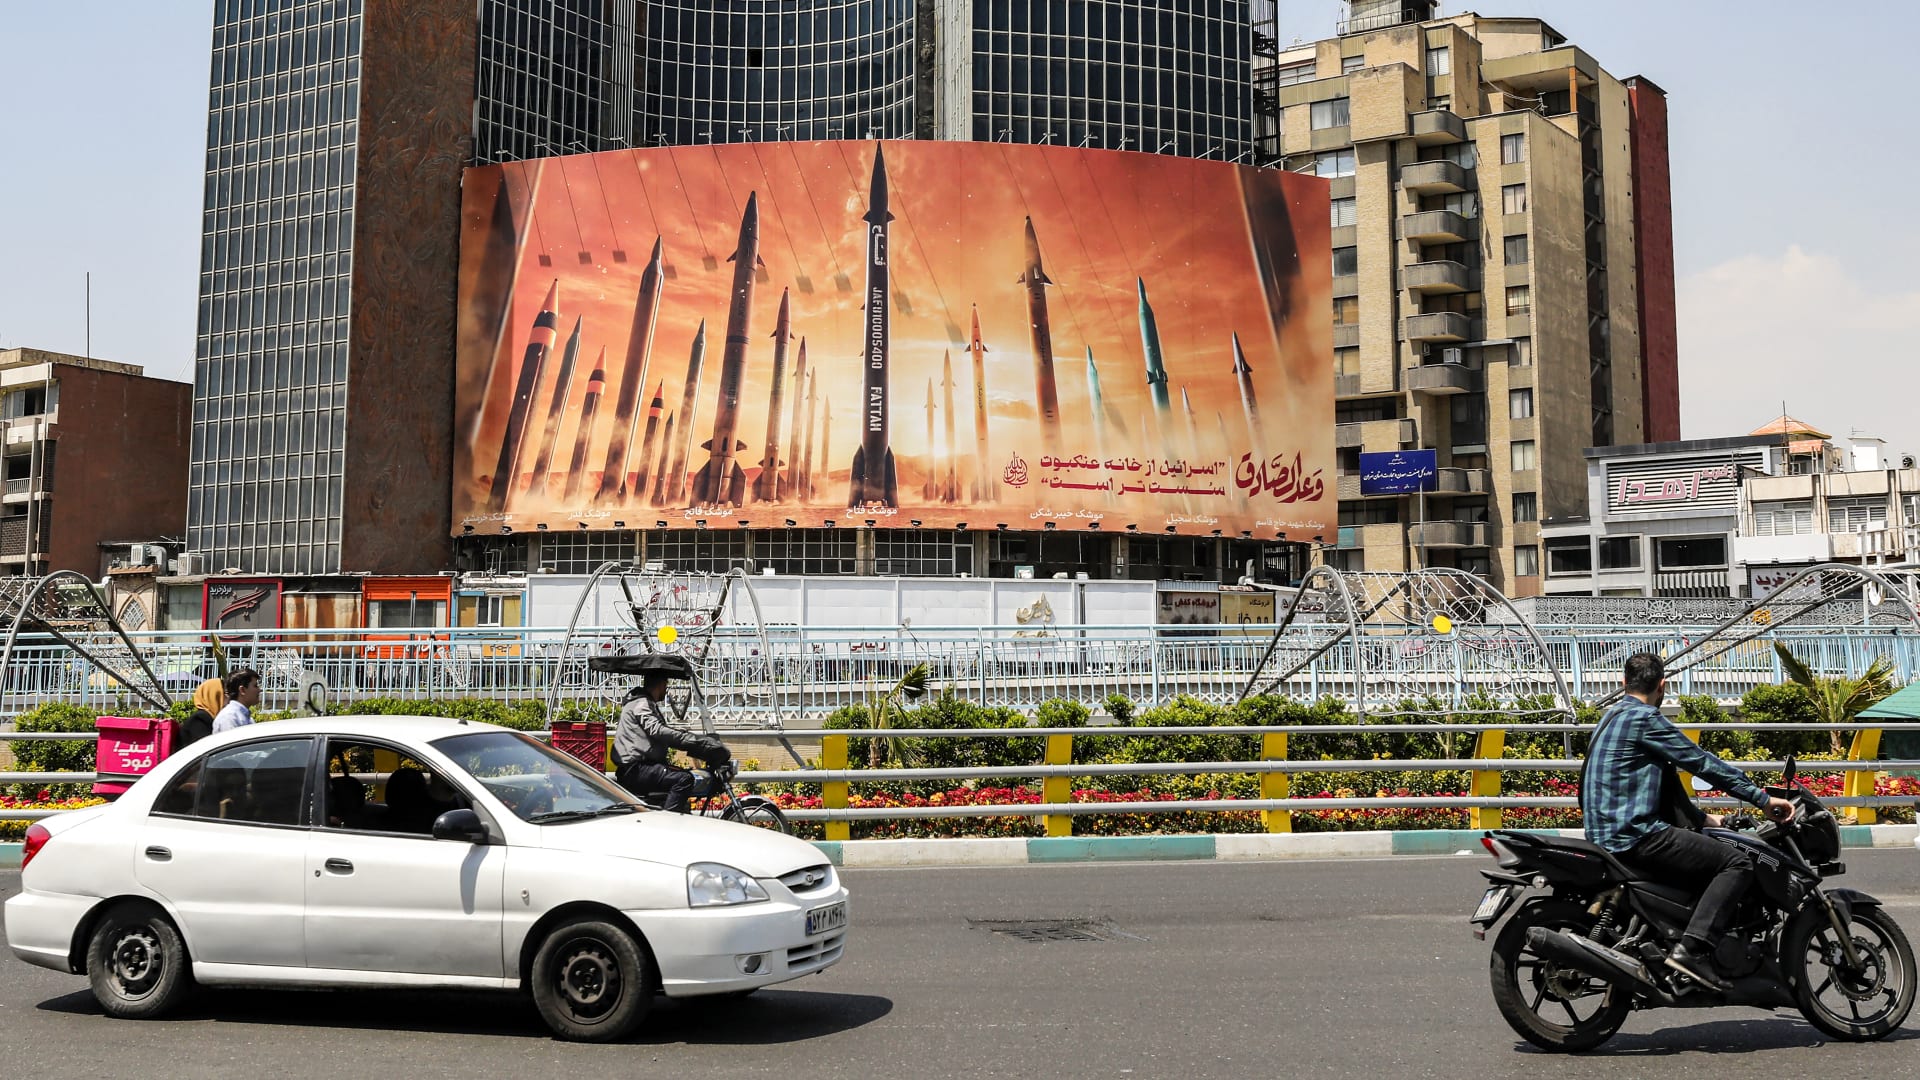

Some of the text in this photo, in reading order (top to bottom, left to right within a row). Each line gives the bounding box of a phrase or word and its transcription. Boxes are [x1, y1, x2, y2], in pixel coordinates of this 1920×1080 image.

[870, 386, 883, 431] FATTAH
[1040, 454, 1100, 472] عنکبوت
[1104, 457, 1142, 472] خانه
[1145, 459, 1156, 476] از
[1118, 480, 1146, 496] تر
[489, 513, 513, 522] موشک
[585, 510, 611, 519] موشک
[684, 506, 733, 519] موشک فاتح
[845, 506, 898, 518] موشک فتاح
[1030, 508, 1104, 521] موشک خیبر شکن
[1166, 513, 1218, 525] موشک سجیل
[1255, 517, 1272, 527] قاسم
[1287, 519, 1303, 528] شهید
[1305, 519, 1325, 529] موشک
[1174, 597, 1191, 608] کفش
[1191, 597, 1217, 608] فروشگاه
[1249, 599, 1270, 607] فروشگاه
[1647, 611, 1666, 620] عصر
[1668, 608, 1682, 620] ولی
[1683, 610, 1713, 620] حضرت
[121, 756, 152, 771] فود
